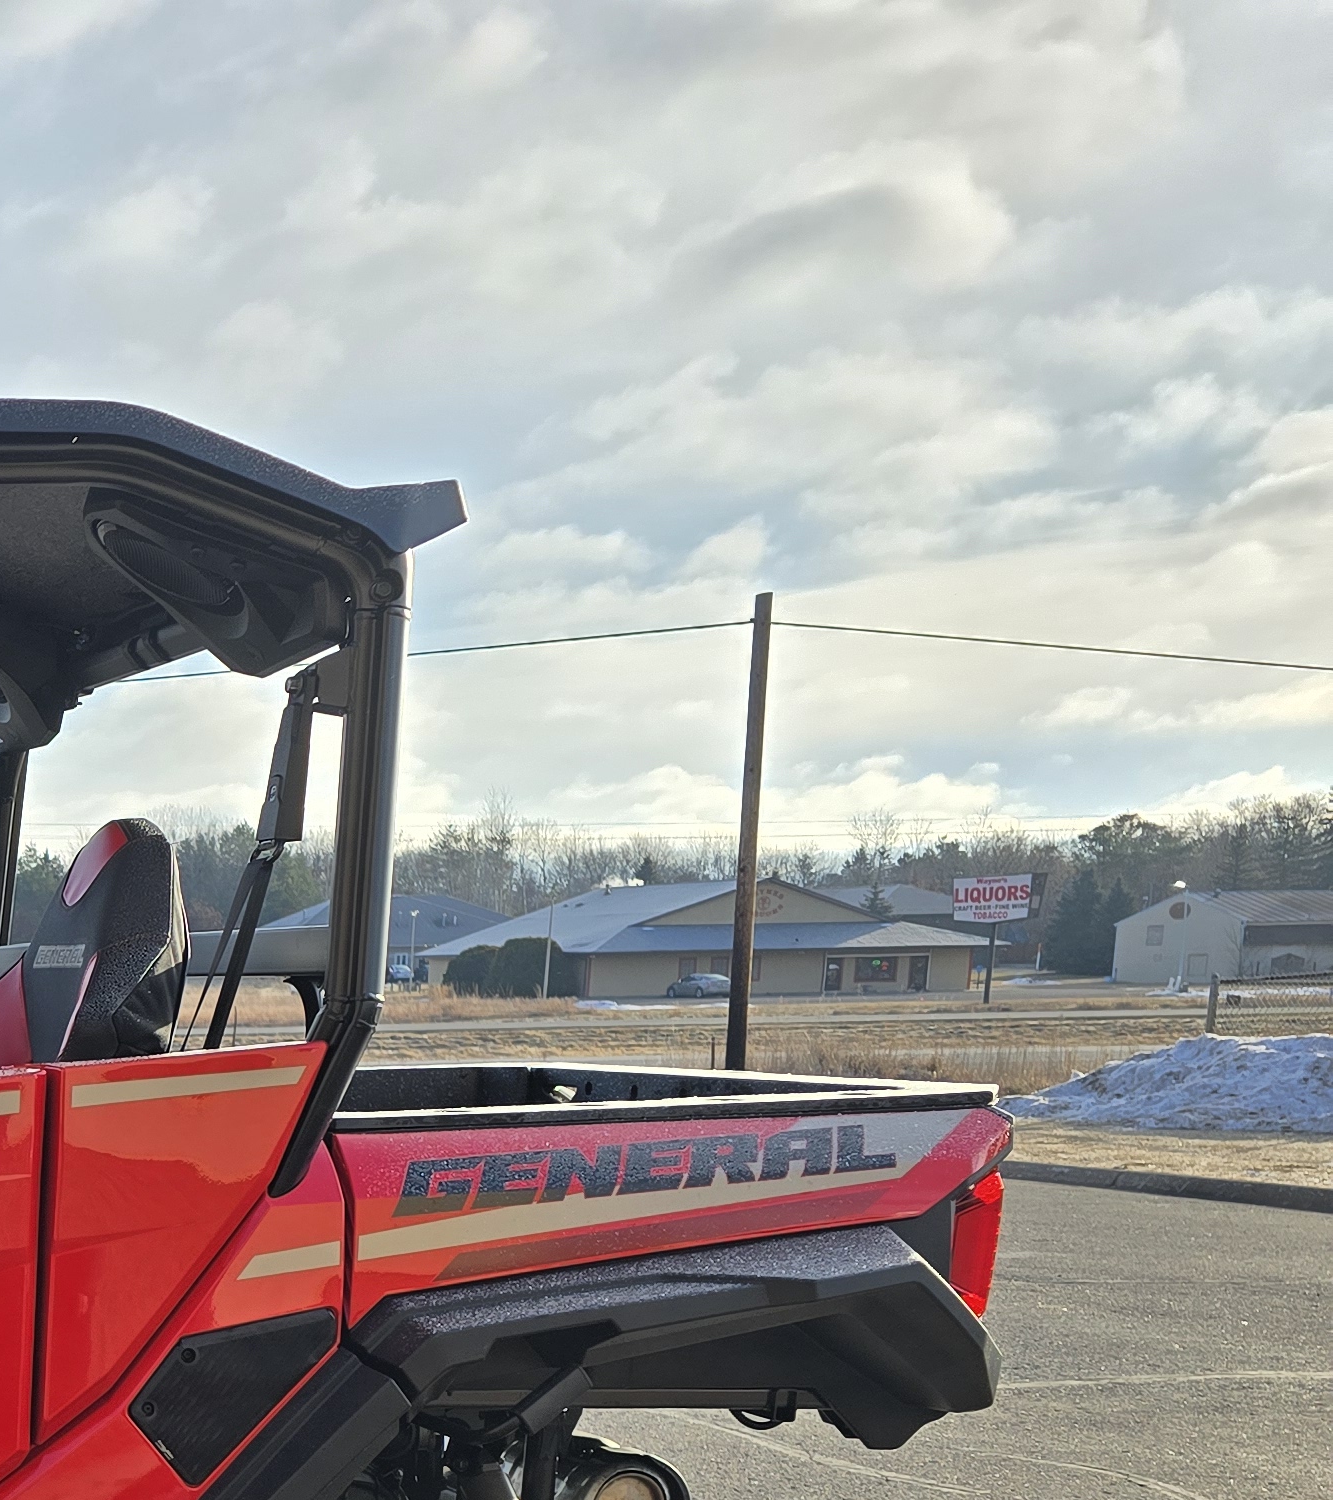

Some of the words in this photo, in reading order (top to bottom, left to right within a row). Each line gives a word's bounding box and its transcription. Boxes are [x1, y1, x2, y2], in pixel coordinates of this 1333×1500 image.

[954, 884, 1031, 904] LIQUORS
[954, 904, 973, 912] CRAFT
[1011, 902, 1028, 910] WINE
[973, 911, 1008, 920] TOBACCO
[35, 945, 84, 967] GENERAL
[391, 1124, 897, 1218] GENERAL
